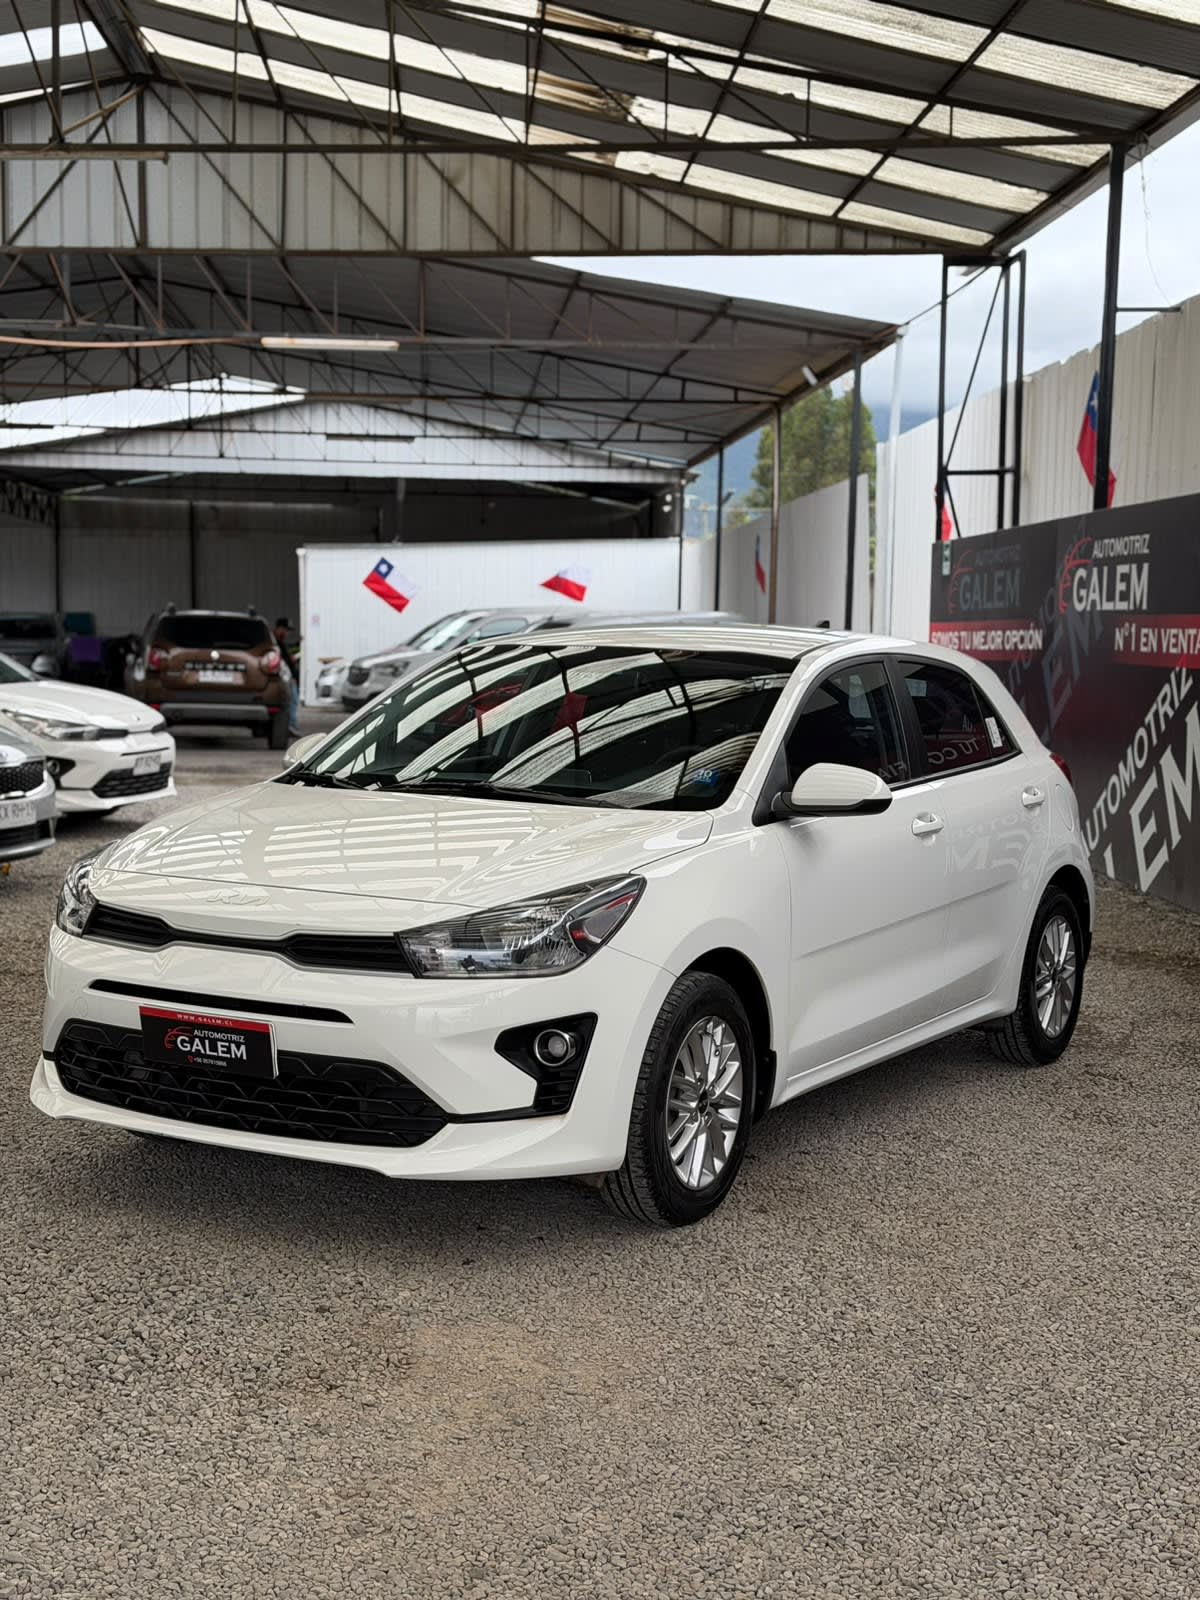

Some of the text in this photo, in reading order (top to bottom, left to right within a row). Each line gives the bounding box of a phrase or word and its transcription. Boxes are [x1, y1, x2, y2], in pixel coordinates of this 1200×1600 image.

[1091, 533, 1151, 559] AUTOMOTRIZ
[959, 567, 1020, 611] GALEM
[1072, 562, 1150, 612] GALEM
[960, 630, 972, 650] TU
[972, 629, 1003, 651] MEJOR
[1003, 622, 1043, 651] OPCIÓN
[1139, 627, 1158, 654] EN
[176, 1035, 247, 1060] GALEM
[193, 1029, 246, 1043] AUTOMOTRIZ
